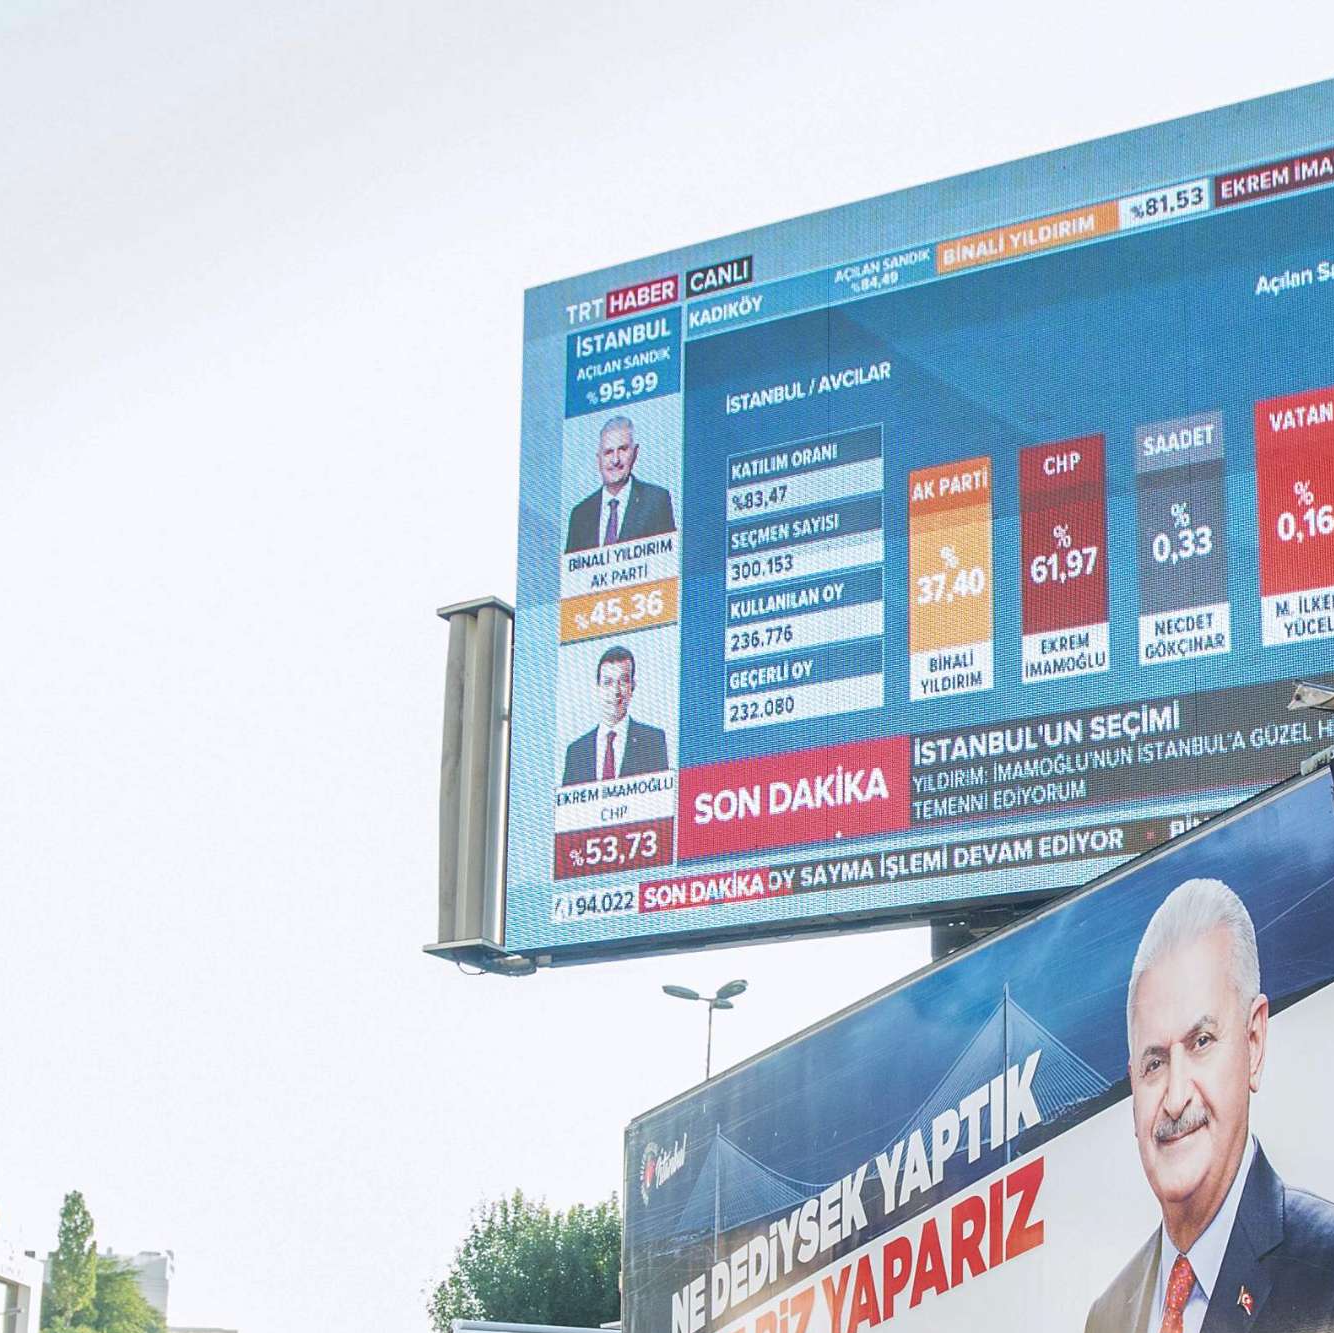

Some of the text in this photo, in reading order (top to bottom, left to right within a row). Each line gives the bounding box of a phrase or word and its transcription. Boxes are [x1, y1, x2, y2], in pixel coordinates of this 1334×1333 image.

[1220, 168, 1289, 199] EKREM
[943, 236, 1005, 265] BİNALİ
[1009, 215, 1095, 250] YILDIRIM
[566, 260, 749, 324] TRT HABER CANLI
[688, 295, 763, 329] KADIKÖY
[576, 318, 671, 358] İSTANBUL
[726, 382, 806, 415] İSTANBUL
[817, 361, 891, 395] AVCILAR
[1269, 401, 1334, 432] VATAN
[1143, 424, 1214, 457] SAADET
[732, 443, 838, 480] KATILIM ORANI
[1043, 451, 1082, 476] CHP
[911, 467, 989, 502] AK PARTİ
[731, 513, 840, 550] SEÇMEN SAYISI
[1152, 525, 1213, 565] 0,33
[569, 538, 673, 573] BİNALİ YILDIRIM
[1030, 546, 1099, 584] 61,97
[591, 563, 648, 588] AK PARTİ
[730, 582, 845, 620] KULLANILAN OY
[1154, 612, 1214, 637] NECDET
[1284, 616, 1334, 639] YÜCEL
[1041, 632, 1090, 655] EKREM
[729, 659, 814, 690] GEÇERLİ OY
[1025, 650, 1106, 679] İMAMOĞLU
[921, 671, 983, 695] YILDIRIM
[914, 699, 1180, 768] İSTANBUL'UN SEÇİMİ
[1250, 721, 1312, 748] GÜZEL
[556, 776, 674, 807] EKREM İMAMOĞLU
[694, 765, 889, 825] SON DAKİKA
[913, 779, 1087, 820] TEMENNİ EDİYORUM
[601, 805, 628, 822] CHP
[569, 830, 658, 867] %53,73
[644, 884, 686, 909] SON
[690, 870, 764, 900] DAKİKA
[768, 868, 796, 892] OY
[800, 860, 874, 888] SAYMA
[880, 844, 948, 880] İŞLEMİ
[953, 838, 1033, 869] DEVAM
[1038, 827, 1124, 858] EDİYOR
[711, 1163, 868, 1321] DEDİYSEK
[875, 1049, 1043, 1215] YAPTIK
